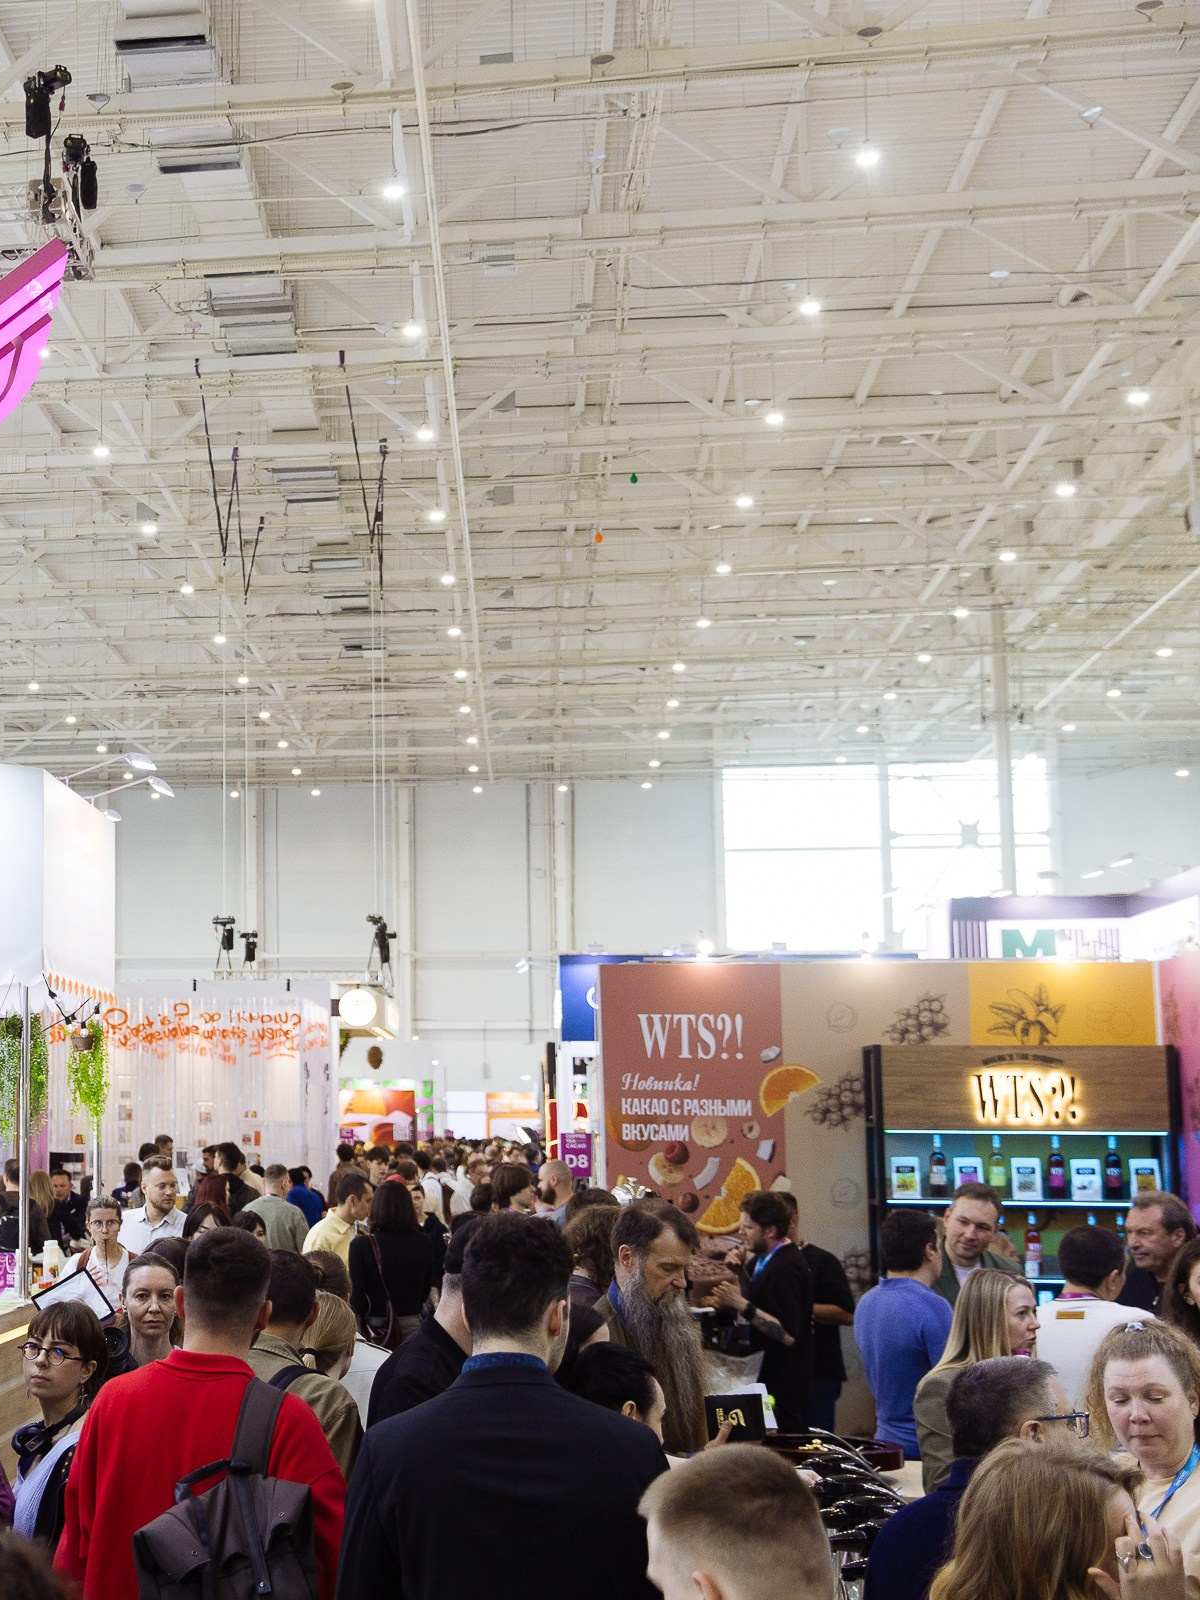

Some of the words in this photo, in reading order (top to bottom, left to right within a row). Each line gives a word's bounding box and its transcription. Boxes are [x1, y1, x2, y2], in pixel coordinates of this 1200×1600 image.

[637, 1013, 744, 1060] WTS?!
[621, 1072, 700, 1091] Новинка!
[972, 1073, 1078, 1121] WTS?!
[621, 1098, 668, 1115] КАКАО
[671, 1099, 681, 1116] С
[683, 1099, 752, 1117] РАЗНЫМИ
[622, 1123, 690, 1141] ВКУСАМИ
[565, 1154, 588, 1168] D8
